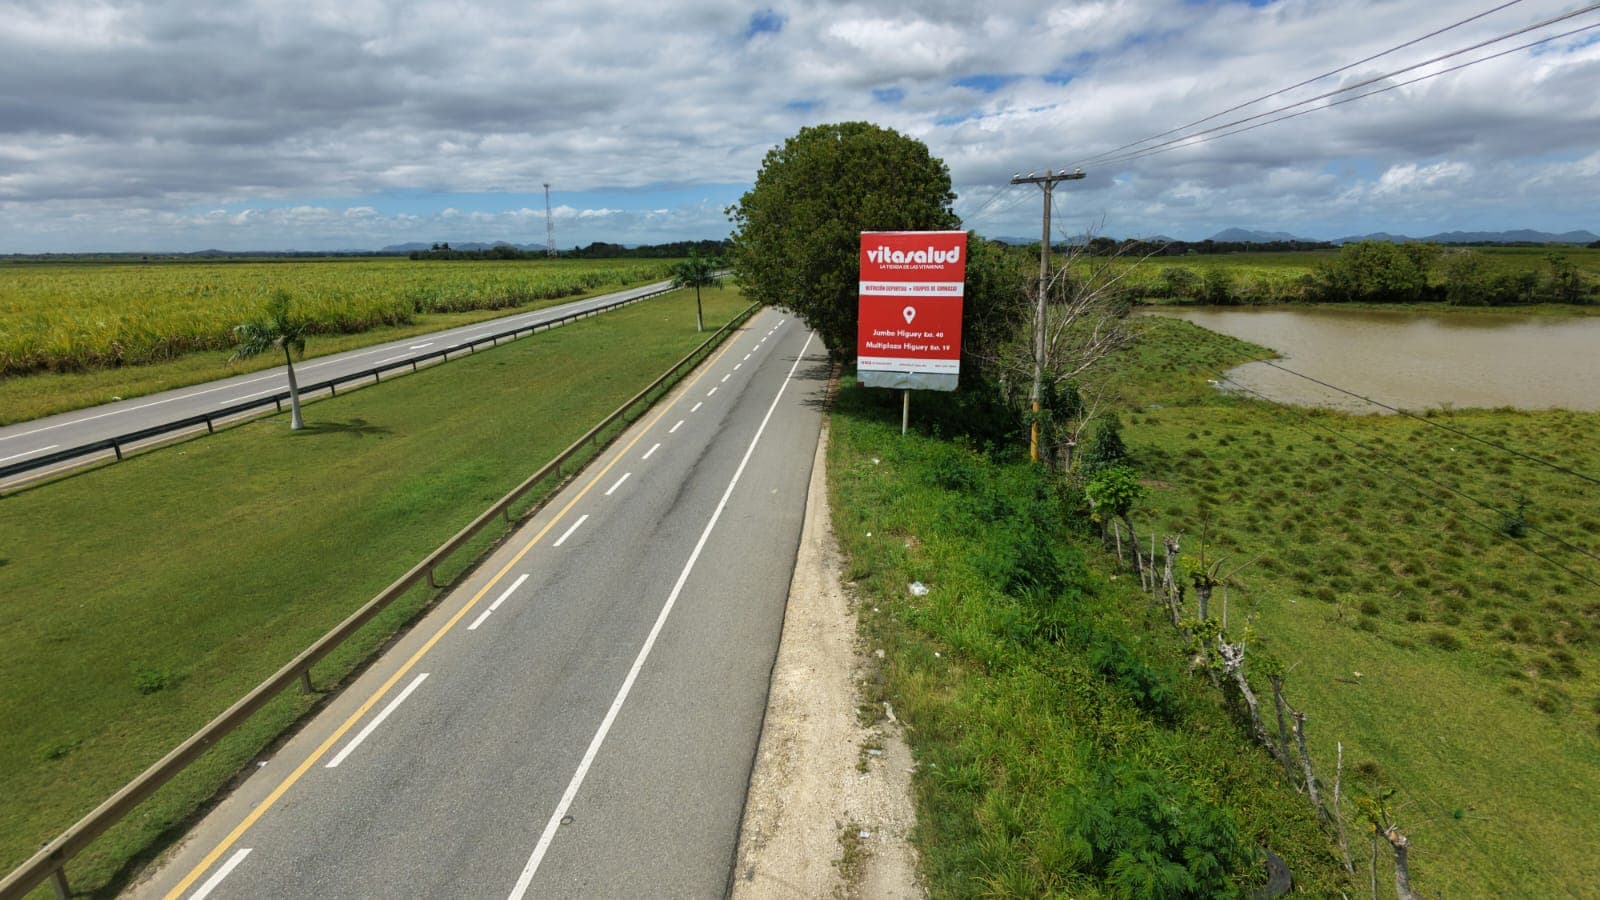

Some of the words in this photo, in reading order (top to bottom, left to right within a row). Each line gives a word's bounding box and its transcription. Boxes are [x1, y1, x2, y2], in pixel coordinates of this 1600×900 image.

[867, 245, 960, 263] vitasalud
[873, 329, 895, 337] Jumbo
[897, 330, 922, 339] Higuey
[866, 341, 902, 351] Multiplaza
[903, 343, 928, 352] Higuey
